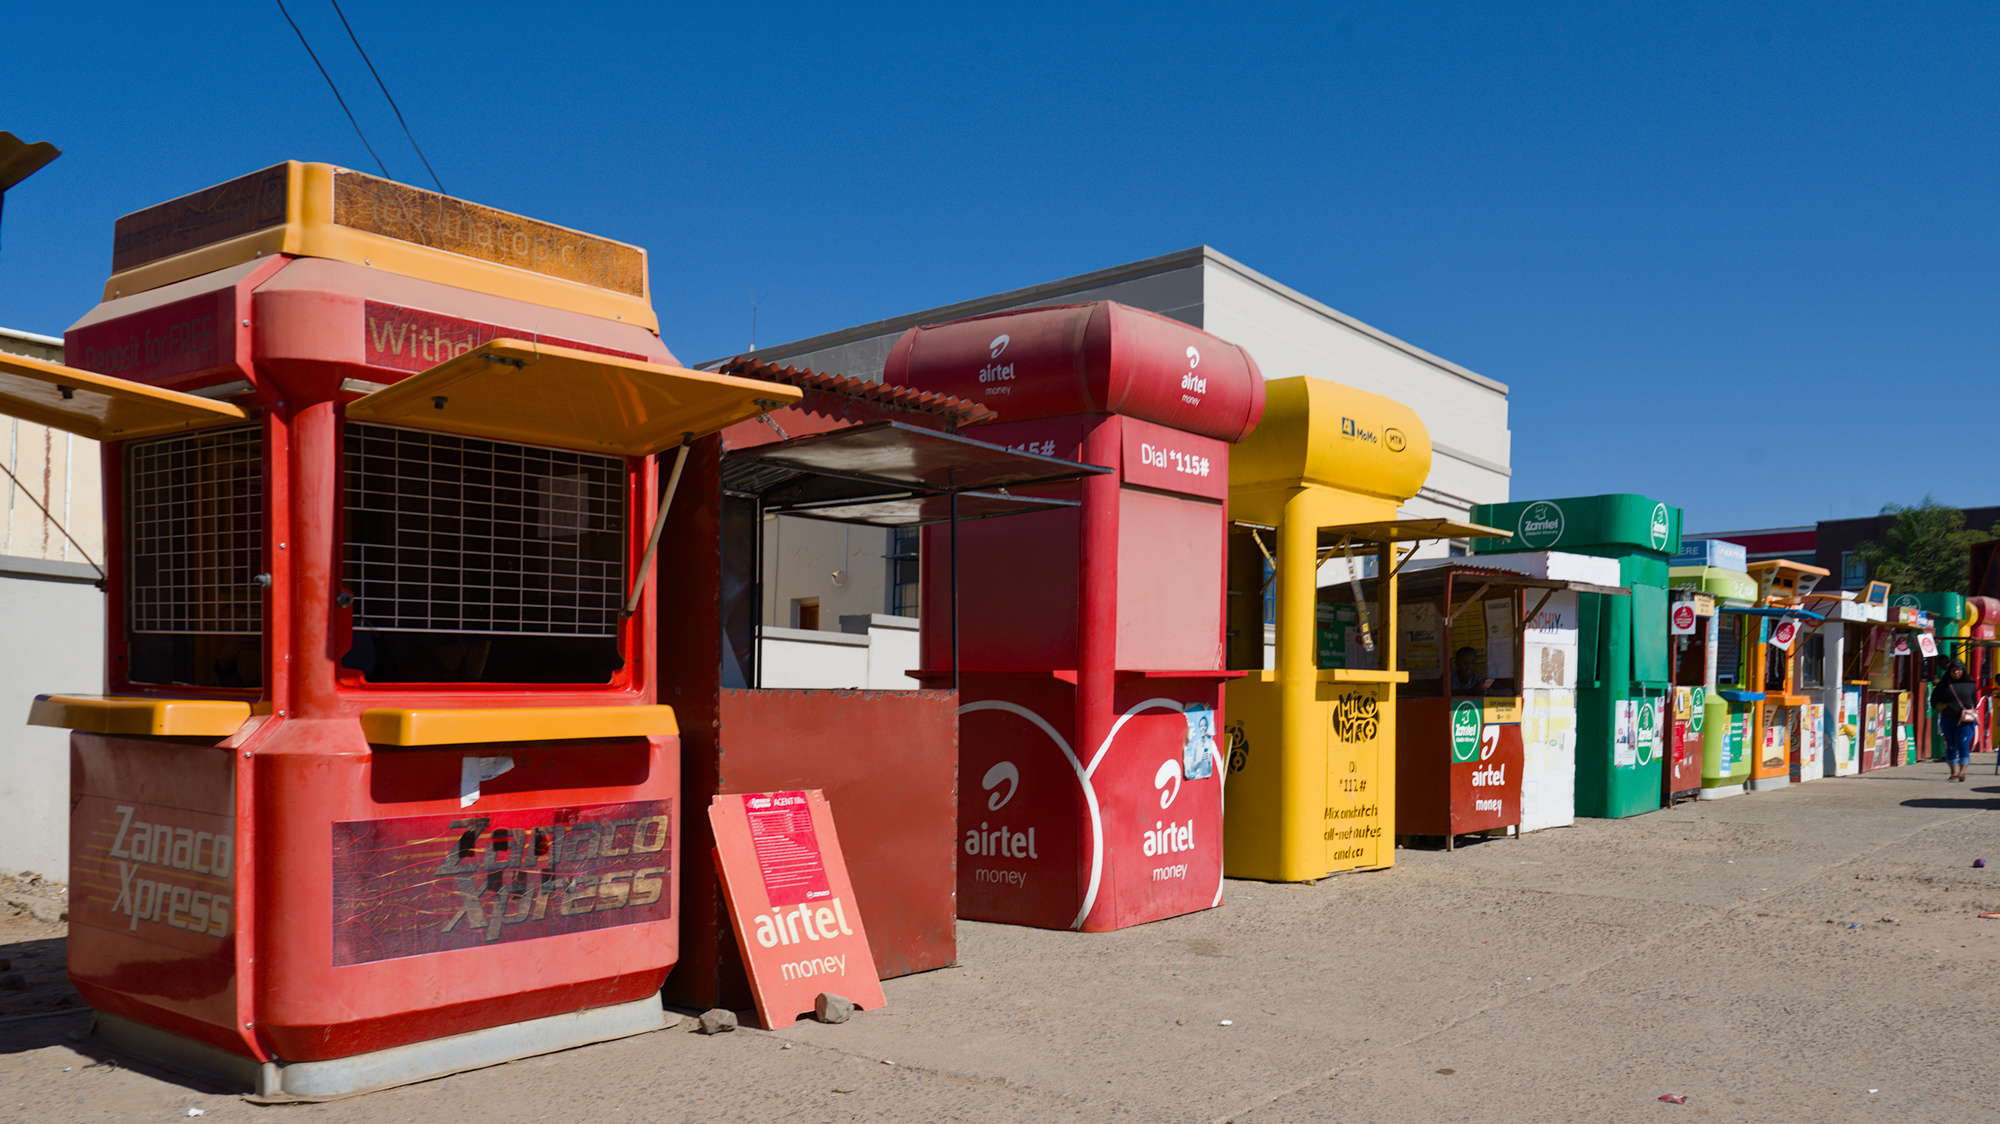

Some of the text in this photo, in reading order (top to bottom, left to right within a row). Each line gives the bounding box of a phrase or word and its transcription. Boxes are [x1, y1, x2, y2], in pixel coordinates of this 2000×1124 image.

[144, 329, 166, 365] for
[169, 316, 212, 358] FREE
[978, 362, 1016, 384] airtel
[1181, 371, 1206, 395] airtel
[985, 384, 1011, 396] money
[1181, 393, 1201, 407] money
[1141, 443, 1167, 469] Dial
[1524, 518, 1559, 532] Zamtel
[1471, 763, 1506, 787] airtel
[1323, 807, 1340, 820] Mix
[1475, 799, 1503, 818] money
[110, 805, 233, 879] Zanaco
[433, 814, 670, 877] Zanaco
[964, 821, 1039, 860] airtel
[1142, 818, 1196, 857] airtel
[975, 868, 1028, 889] money
[1152, 863, 1188, 882] money
[111, 861, 231, 939] Xpress
[440, 865, 667, 942] Xpress
[753, 897, 854, 949] airtel
[780, 953, 846, 981] money
